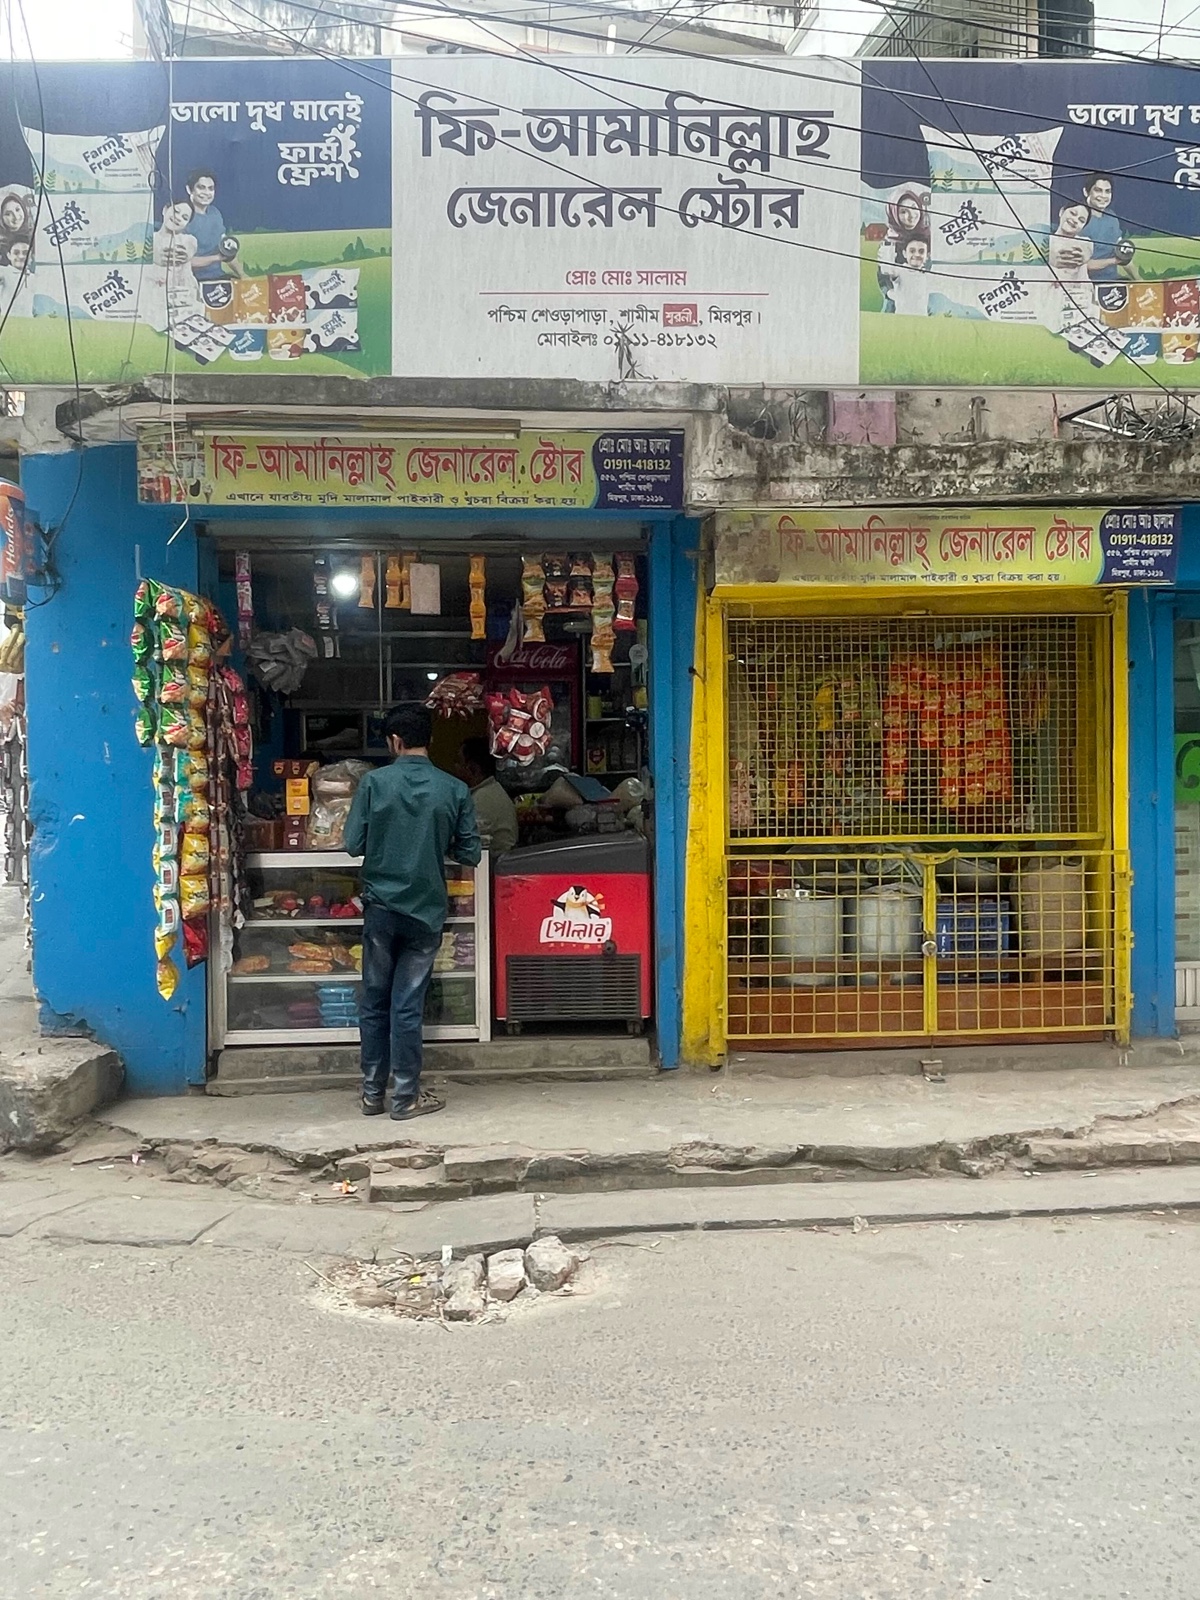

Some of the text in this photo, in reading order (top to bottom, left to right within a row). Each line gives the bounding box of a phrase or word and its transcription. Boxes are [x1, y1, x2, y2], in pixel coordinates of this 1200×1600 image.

[171, 92, 364, 133] ভালো দুধ মানেই
[1067, 104, 1139, 126] ভালো
[1143, 104, 1184, 137] দুধ
[82, 139, 117, 163] Farm
[89, 148, 126, 175] Fresh
[278, 137, 342, 163] ফার্ম
[278, 163, 344, 187] ফ্রেশ
[446, 173, 805, 231] জেনারেল স্টোর
[565, 269, 688, 287] প্রোঃ মোঃ সালাম
[83, 281, 117, 305] Farm
[89, 289, 126, 316] Fresh
[978, 282, 1013, 305] Farm
[984, 291, 1022, 317] Fresh
[488, 304, 527, 323] পশ্চিম
[619, 304, 659, 323] শামীম
[537, 329, 718, 349] মোবাইলঃ ০১১১-৪১৮১৩২
[406, 446, 521, 485] জেনারেল
[603, 458, 671, 470] 01911-418132
[226, 492, 265, 502] এখানে
[269, 491, 312, 502] যাবতীয়
[318, 491, 338, 504] মুদি
[344, 494, 391, 503] মালামাল
[397, 493, 444, 504] পাইকারী
[450, 497, 459, 506] ও
[534, 496, 554, 506] করা
[940, 522, 1036, 562] জেনারেল
[1109, 533, 1174, 546] 01911-418132
[881, 574, 917, 582] মালামাল
[921, 573, 957, 583] পাইকারী
[998, 572, 1023, 582] বিক্রয়
[1027, 573, 1043, 581] করা
[546, 920, 606, 942] পোলার
